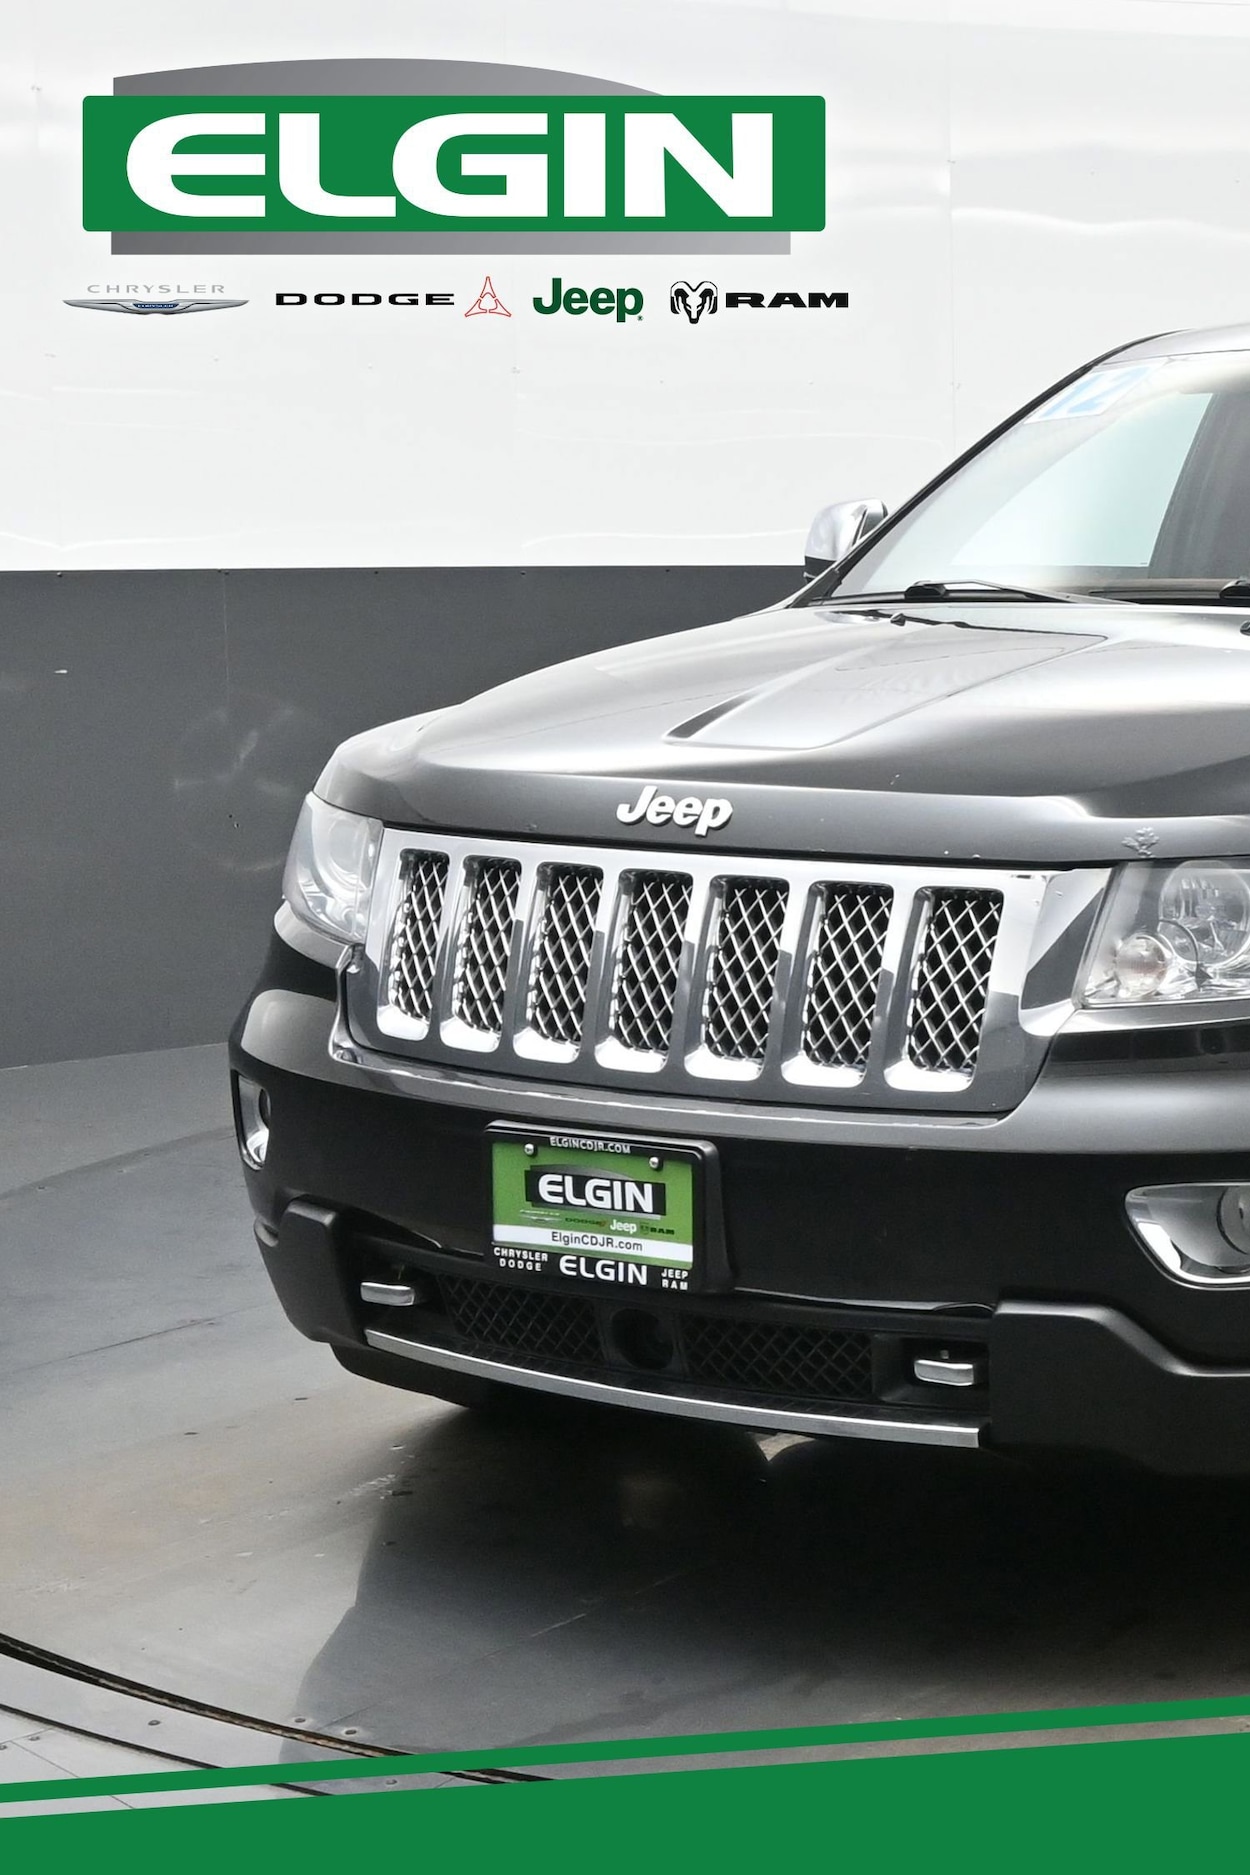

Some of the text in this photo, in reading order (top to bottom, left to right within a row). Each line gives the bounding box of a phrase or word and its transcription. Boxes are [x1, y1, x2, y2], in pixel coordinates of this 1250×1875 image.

[616, 785, 733, 837] Jeep
[549, 1136, 632, 1154] ELGINCDJR.COM
[538, 1173, 653, 1213] ELGIN
[609, 1219, 637, 1233] Jeep
[551, 1231, 643, 1252] ElginCDJR.com
[493, 1247, 549, 1263] CHRYSLER
[499, 1258, 542, 1272] DODGE
[559, 1255, 648, 1286] ELGIN
[661, 1268, 689, 1280] JEEP
[662, 1279, 689, 1291] RAM
